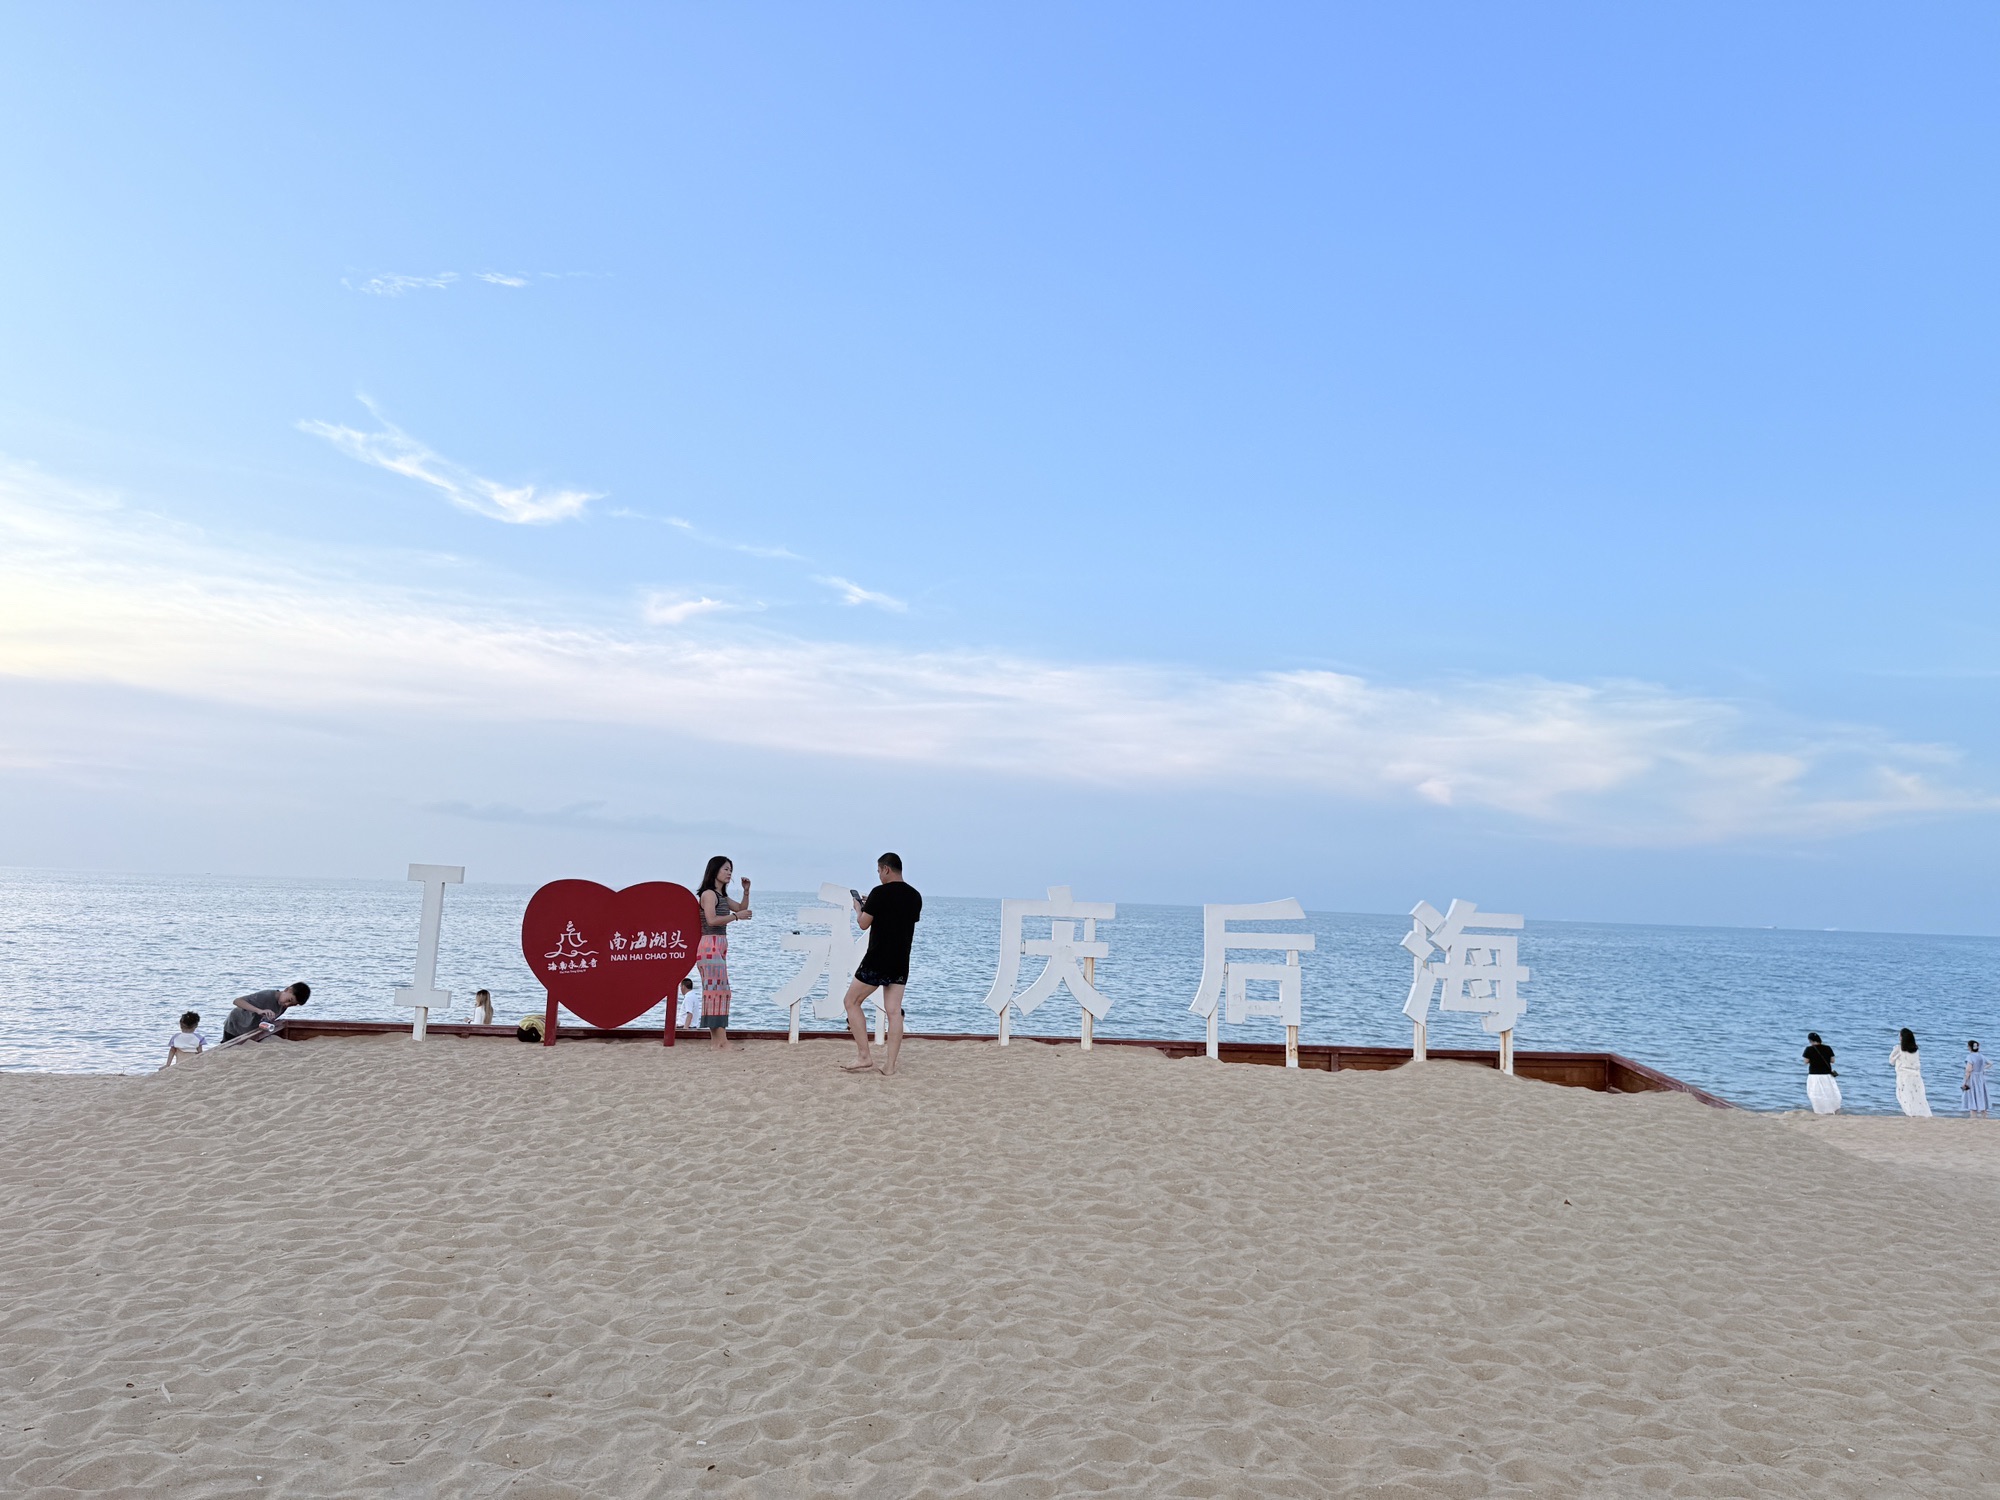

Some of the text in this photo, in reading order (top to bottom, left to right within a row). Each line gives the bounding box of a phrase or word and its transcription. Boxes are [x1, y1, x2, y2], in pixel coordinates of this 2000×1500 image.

[393, 863, 465, 1009] I
[609, 930, 688, 951] 南海潮头
[610, 951, 685, 962] NAN HAI CHAO TOU
